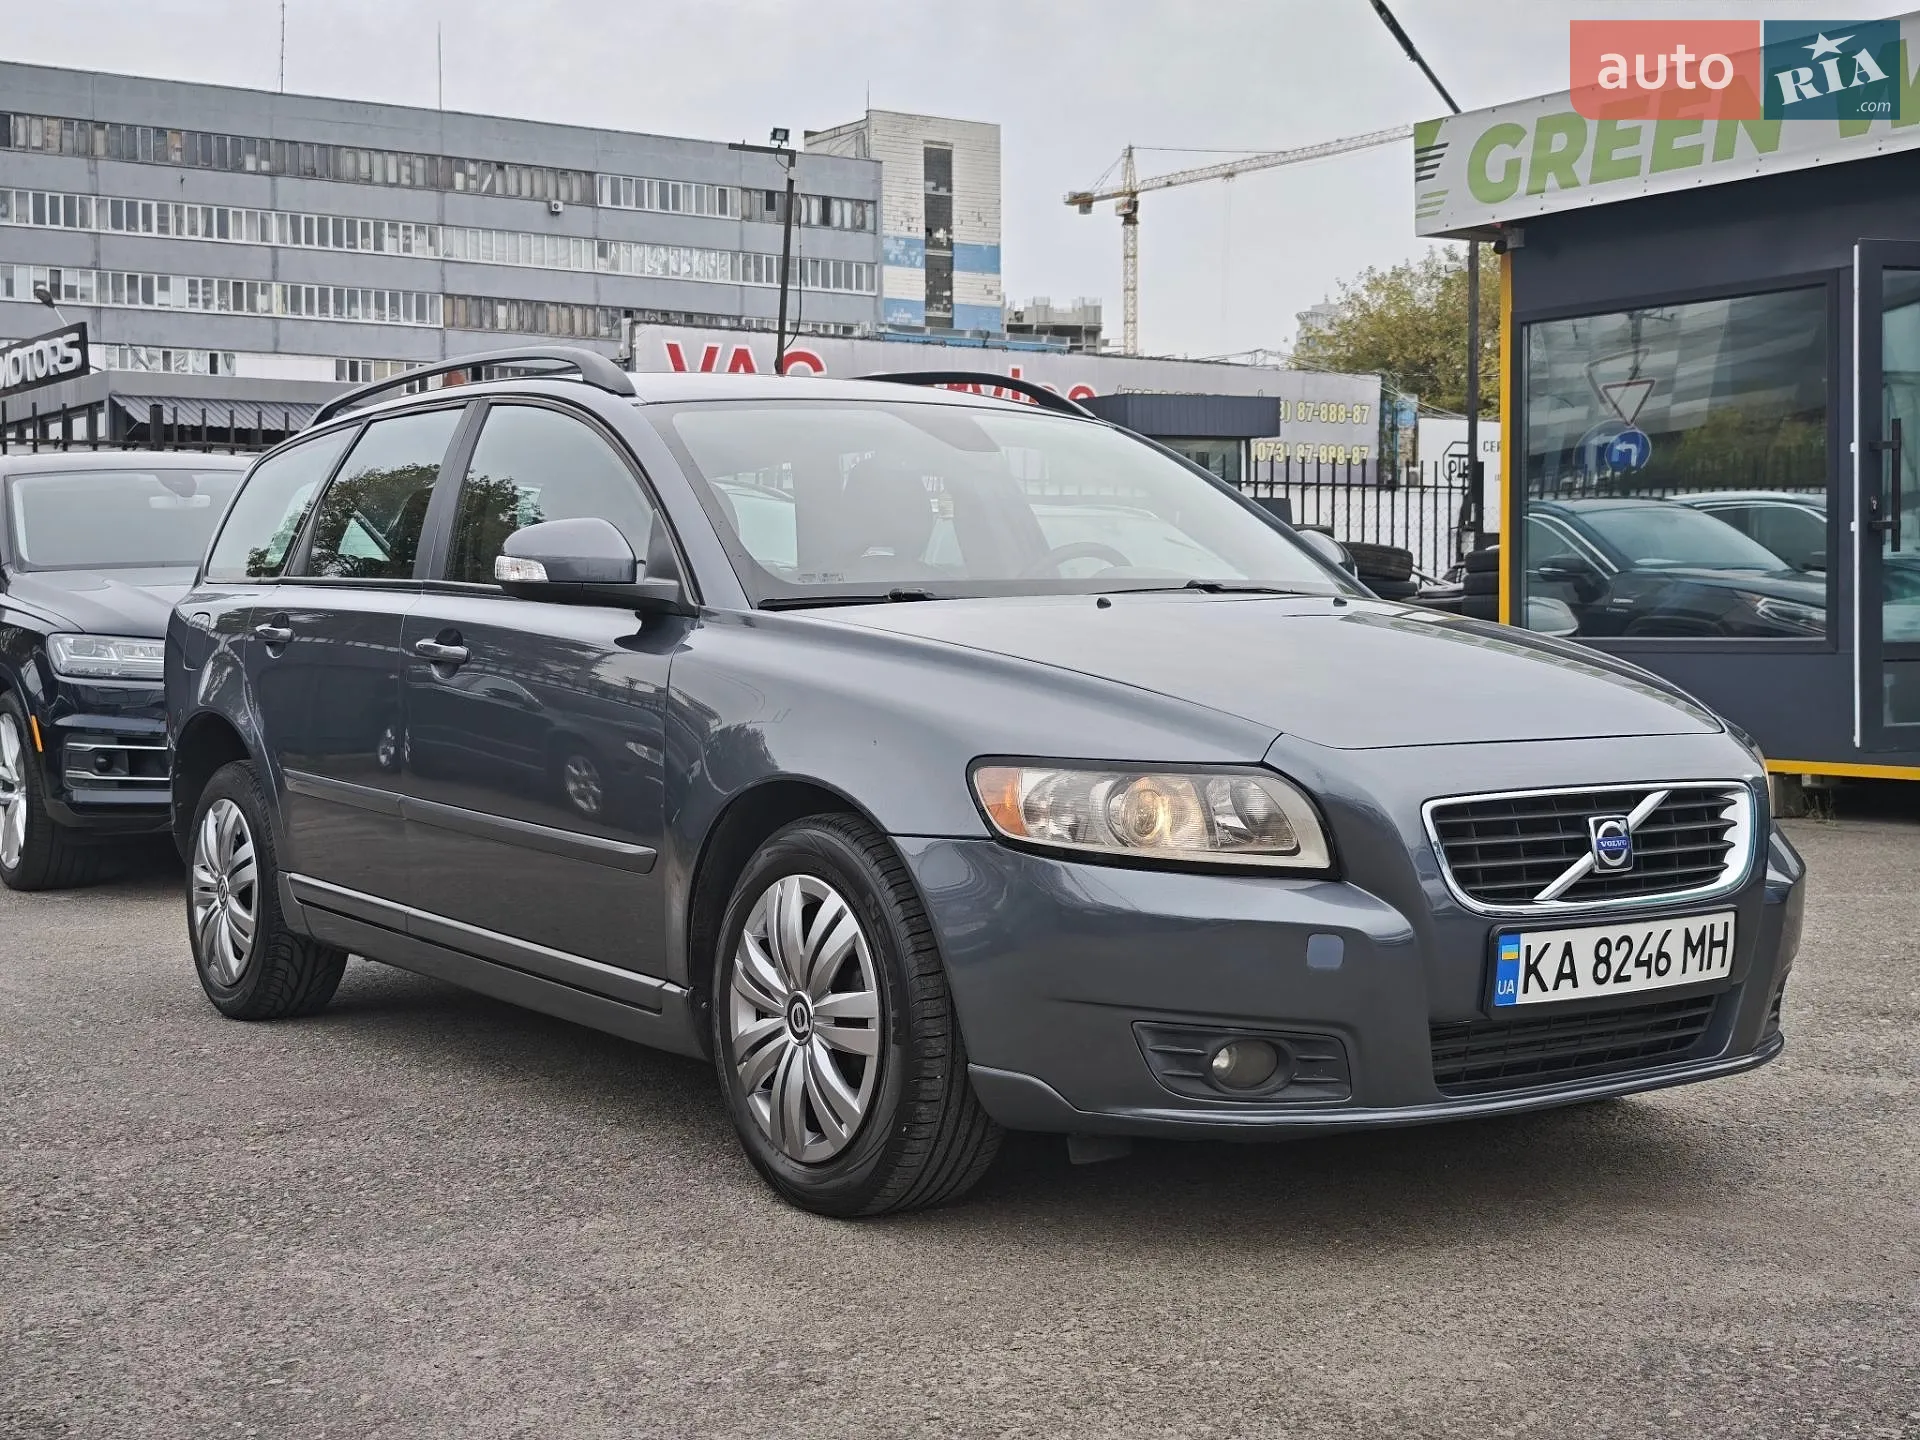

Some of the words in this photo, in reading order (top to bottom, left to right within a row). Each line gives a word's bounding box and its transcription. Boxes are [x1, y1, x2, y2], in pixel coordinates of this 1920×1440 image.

[1467, 64, 1791, 204] GREEN
[1297, 401, 1371, 424] 87-888-87
[1600, 839, 1627, 848] VOLVO
[1497, 979, 1515, 995] UA
[1522, 941, 1580, 995] KA
[1592, 928, 1672, 986] 8246
[1680, 921, 1729, 975] MH
